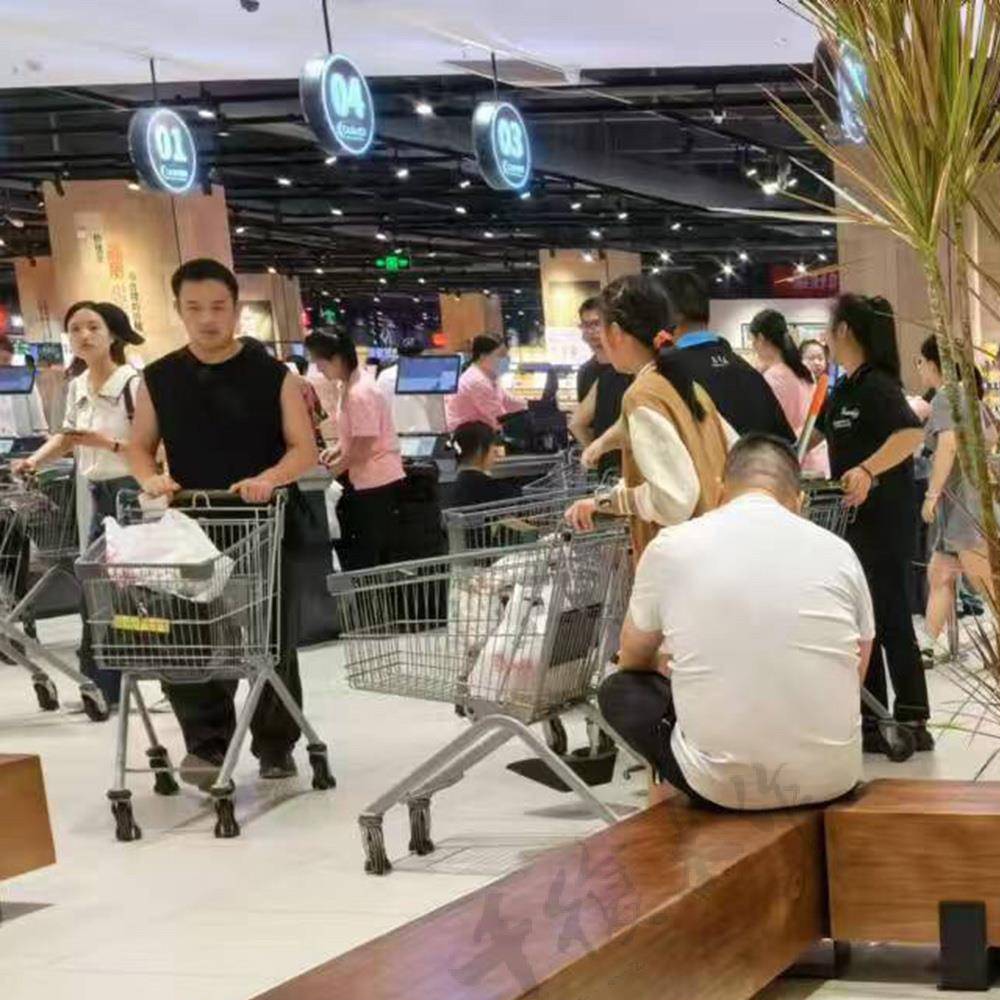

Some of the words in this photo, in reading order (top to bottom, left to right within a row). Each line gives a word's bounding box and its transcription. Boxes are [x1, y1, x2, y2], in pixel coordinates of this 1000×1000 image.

[330, 73, 366, 119] 04
[155, 125, 187, 162] 01
[497, 118, 525, 158] 03
